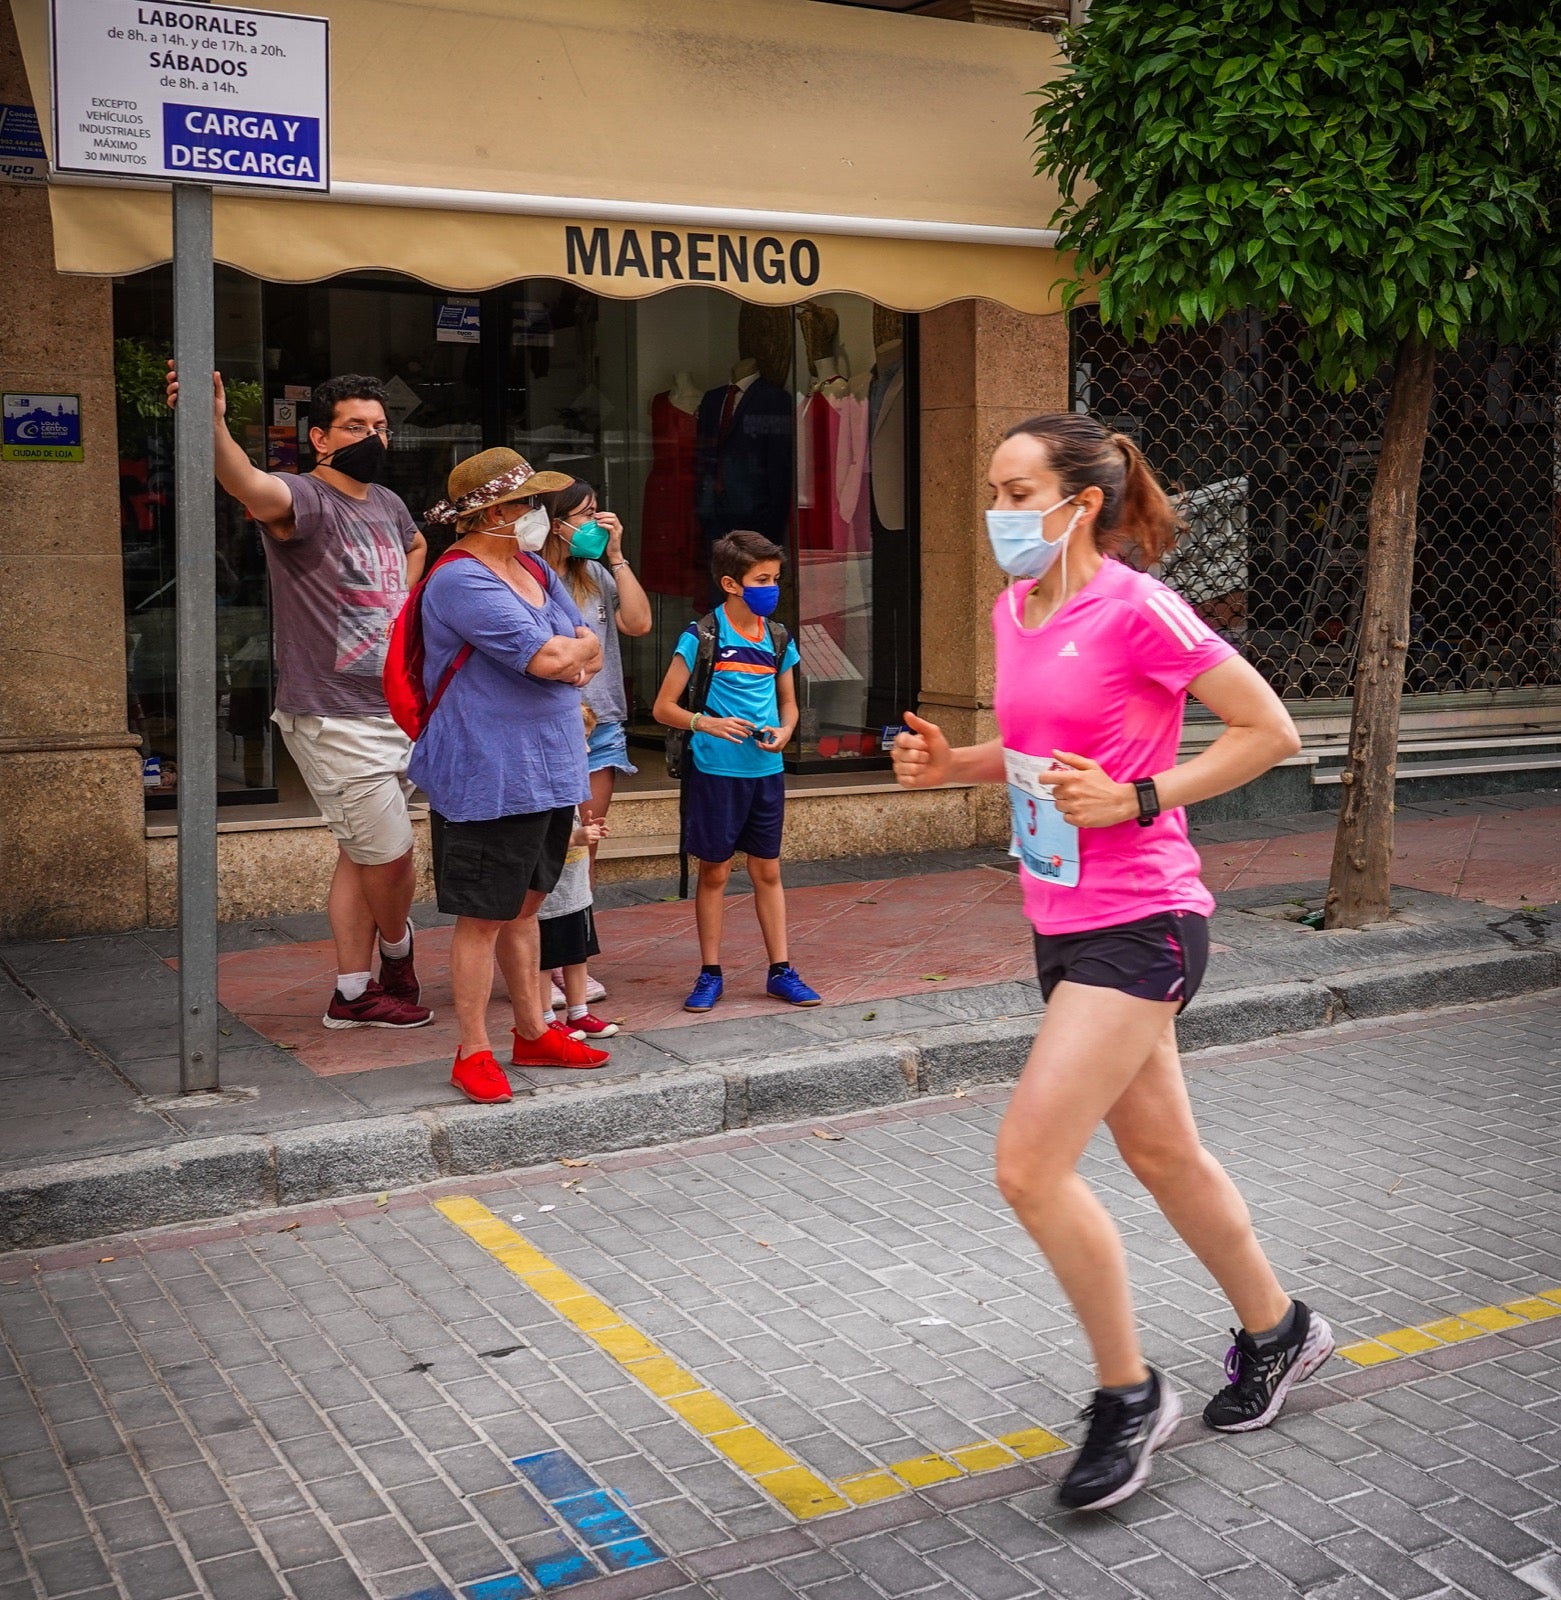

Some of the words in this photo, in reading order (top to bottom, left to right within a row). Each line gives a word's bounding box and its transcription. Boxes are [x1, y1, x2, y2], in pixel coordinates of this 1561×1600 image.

[138, 8, 258, 37] LABORALES
[107, 26, 125, 39] de
[127, 29, 148, 42] 8h.
[150, 34, 158, 43] a
[162, 33, 189, 47] 14h.
[191, 38, 199, 50] y
[201, 37, 218, 50] de
[222, 40, 248, 53] 17h.
[250, 45, 258, 54] a
[260, 44, 287, 58] 20h.
[149, 50, 248, 77] SÁBADOS
[160, 75, 177, 88] de
[179, 77, 199, 90] 8h.
[201, 82, 209, 91] a
[213, 81, 239, 94] 14h.
[91, 97, 138, 111] EXCEPTO
[86, 110, 144, 125] VEHÍCULOS
[184, 111, 279, 141] CARGA
[282, 120, 300, 142] Y
[79, 123, 152, 139] INDUSTRIALES
[93, 138, 138, 151] MÁXIMO
[84, 151, 98, 161] 30
[99, 152, 147, 165] MINUTOS
[171, 144, 315, 178] DESCARGA
[565, 225, 820, 286] MARENGO
[13, 449, 42, 457] CIUDAD
[55, 450, 73, 458] LOJA
[1027, 799, 1038, 836] 3
